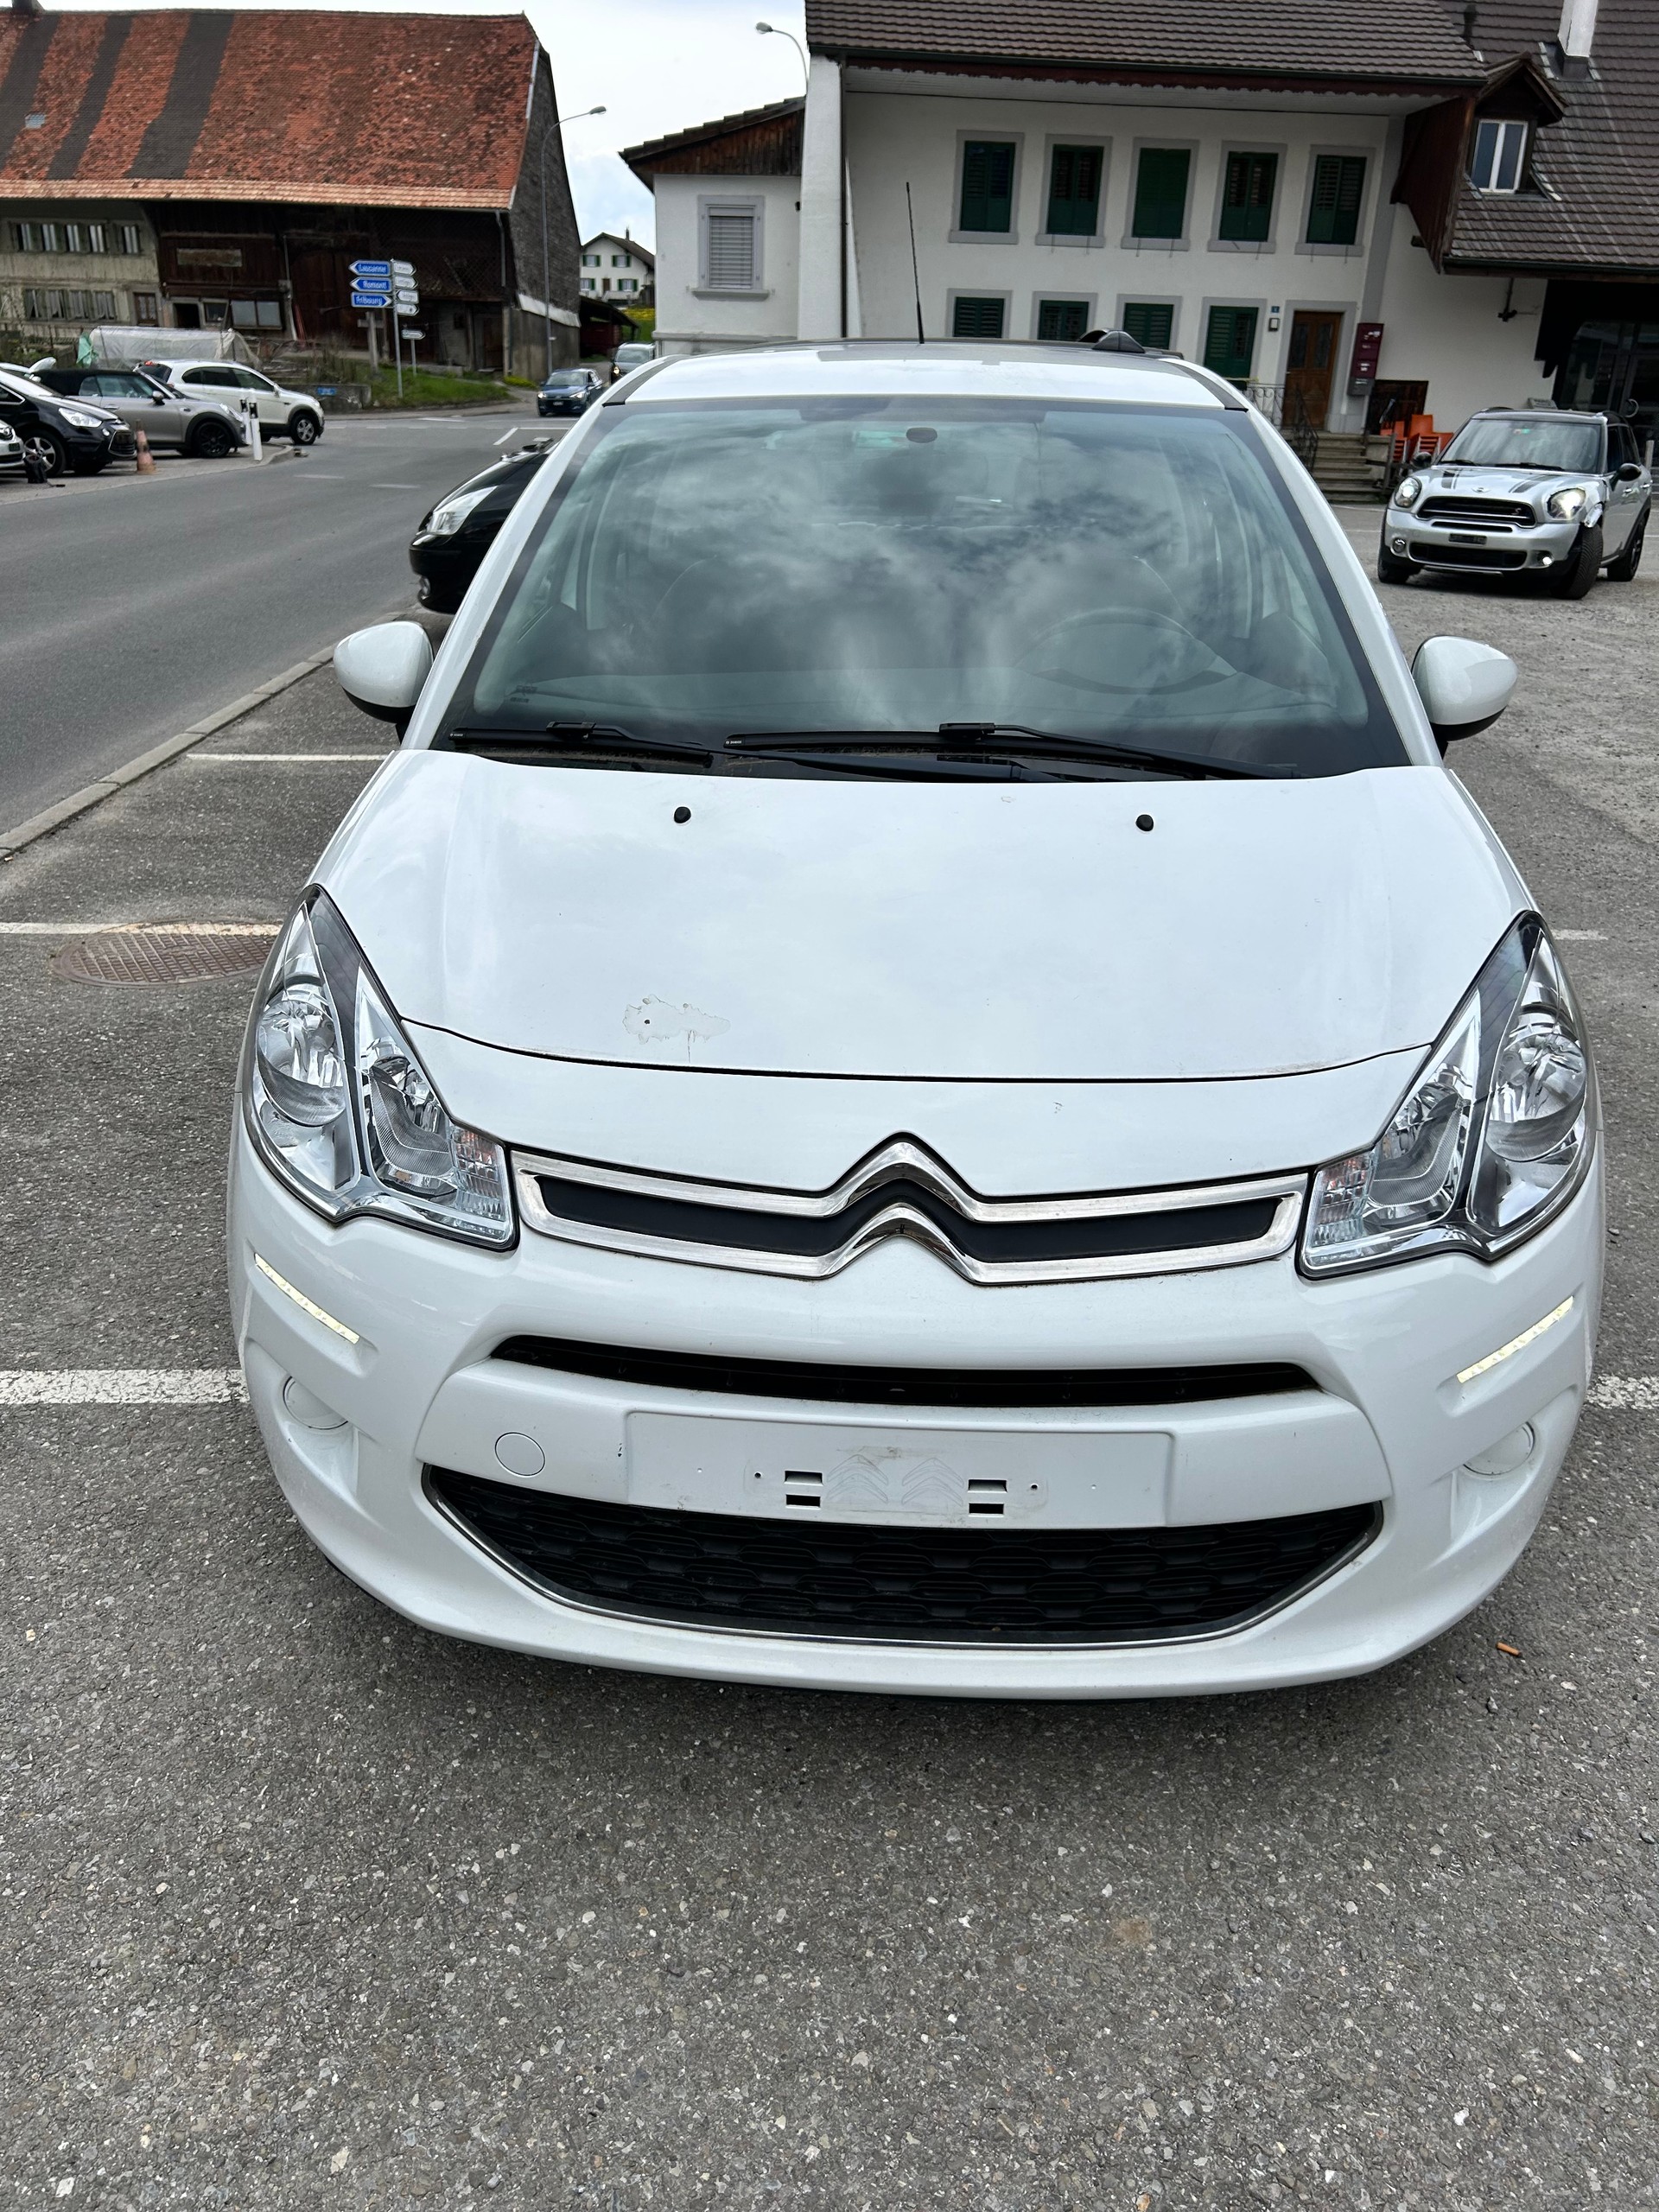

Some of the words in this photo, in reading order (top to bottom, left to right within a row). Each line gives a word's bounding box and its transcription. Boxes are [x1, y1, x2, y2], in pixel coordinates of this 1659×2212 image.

[358, 264, 387, 273] Lausanne
[363, 280, 388, 289] Romont
[355, 296, 383, 307] Fribourg
